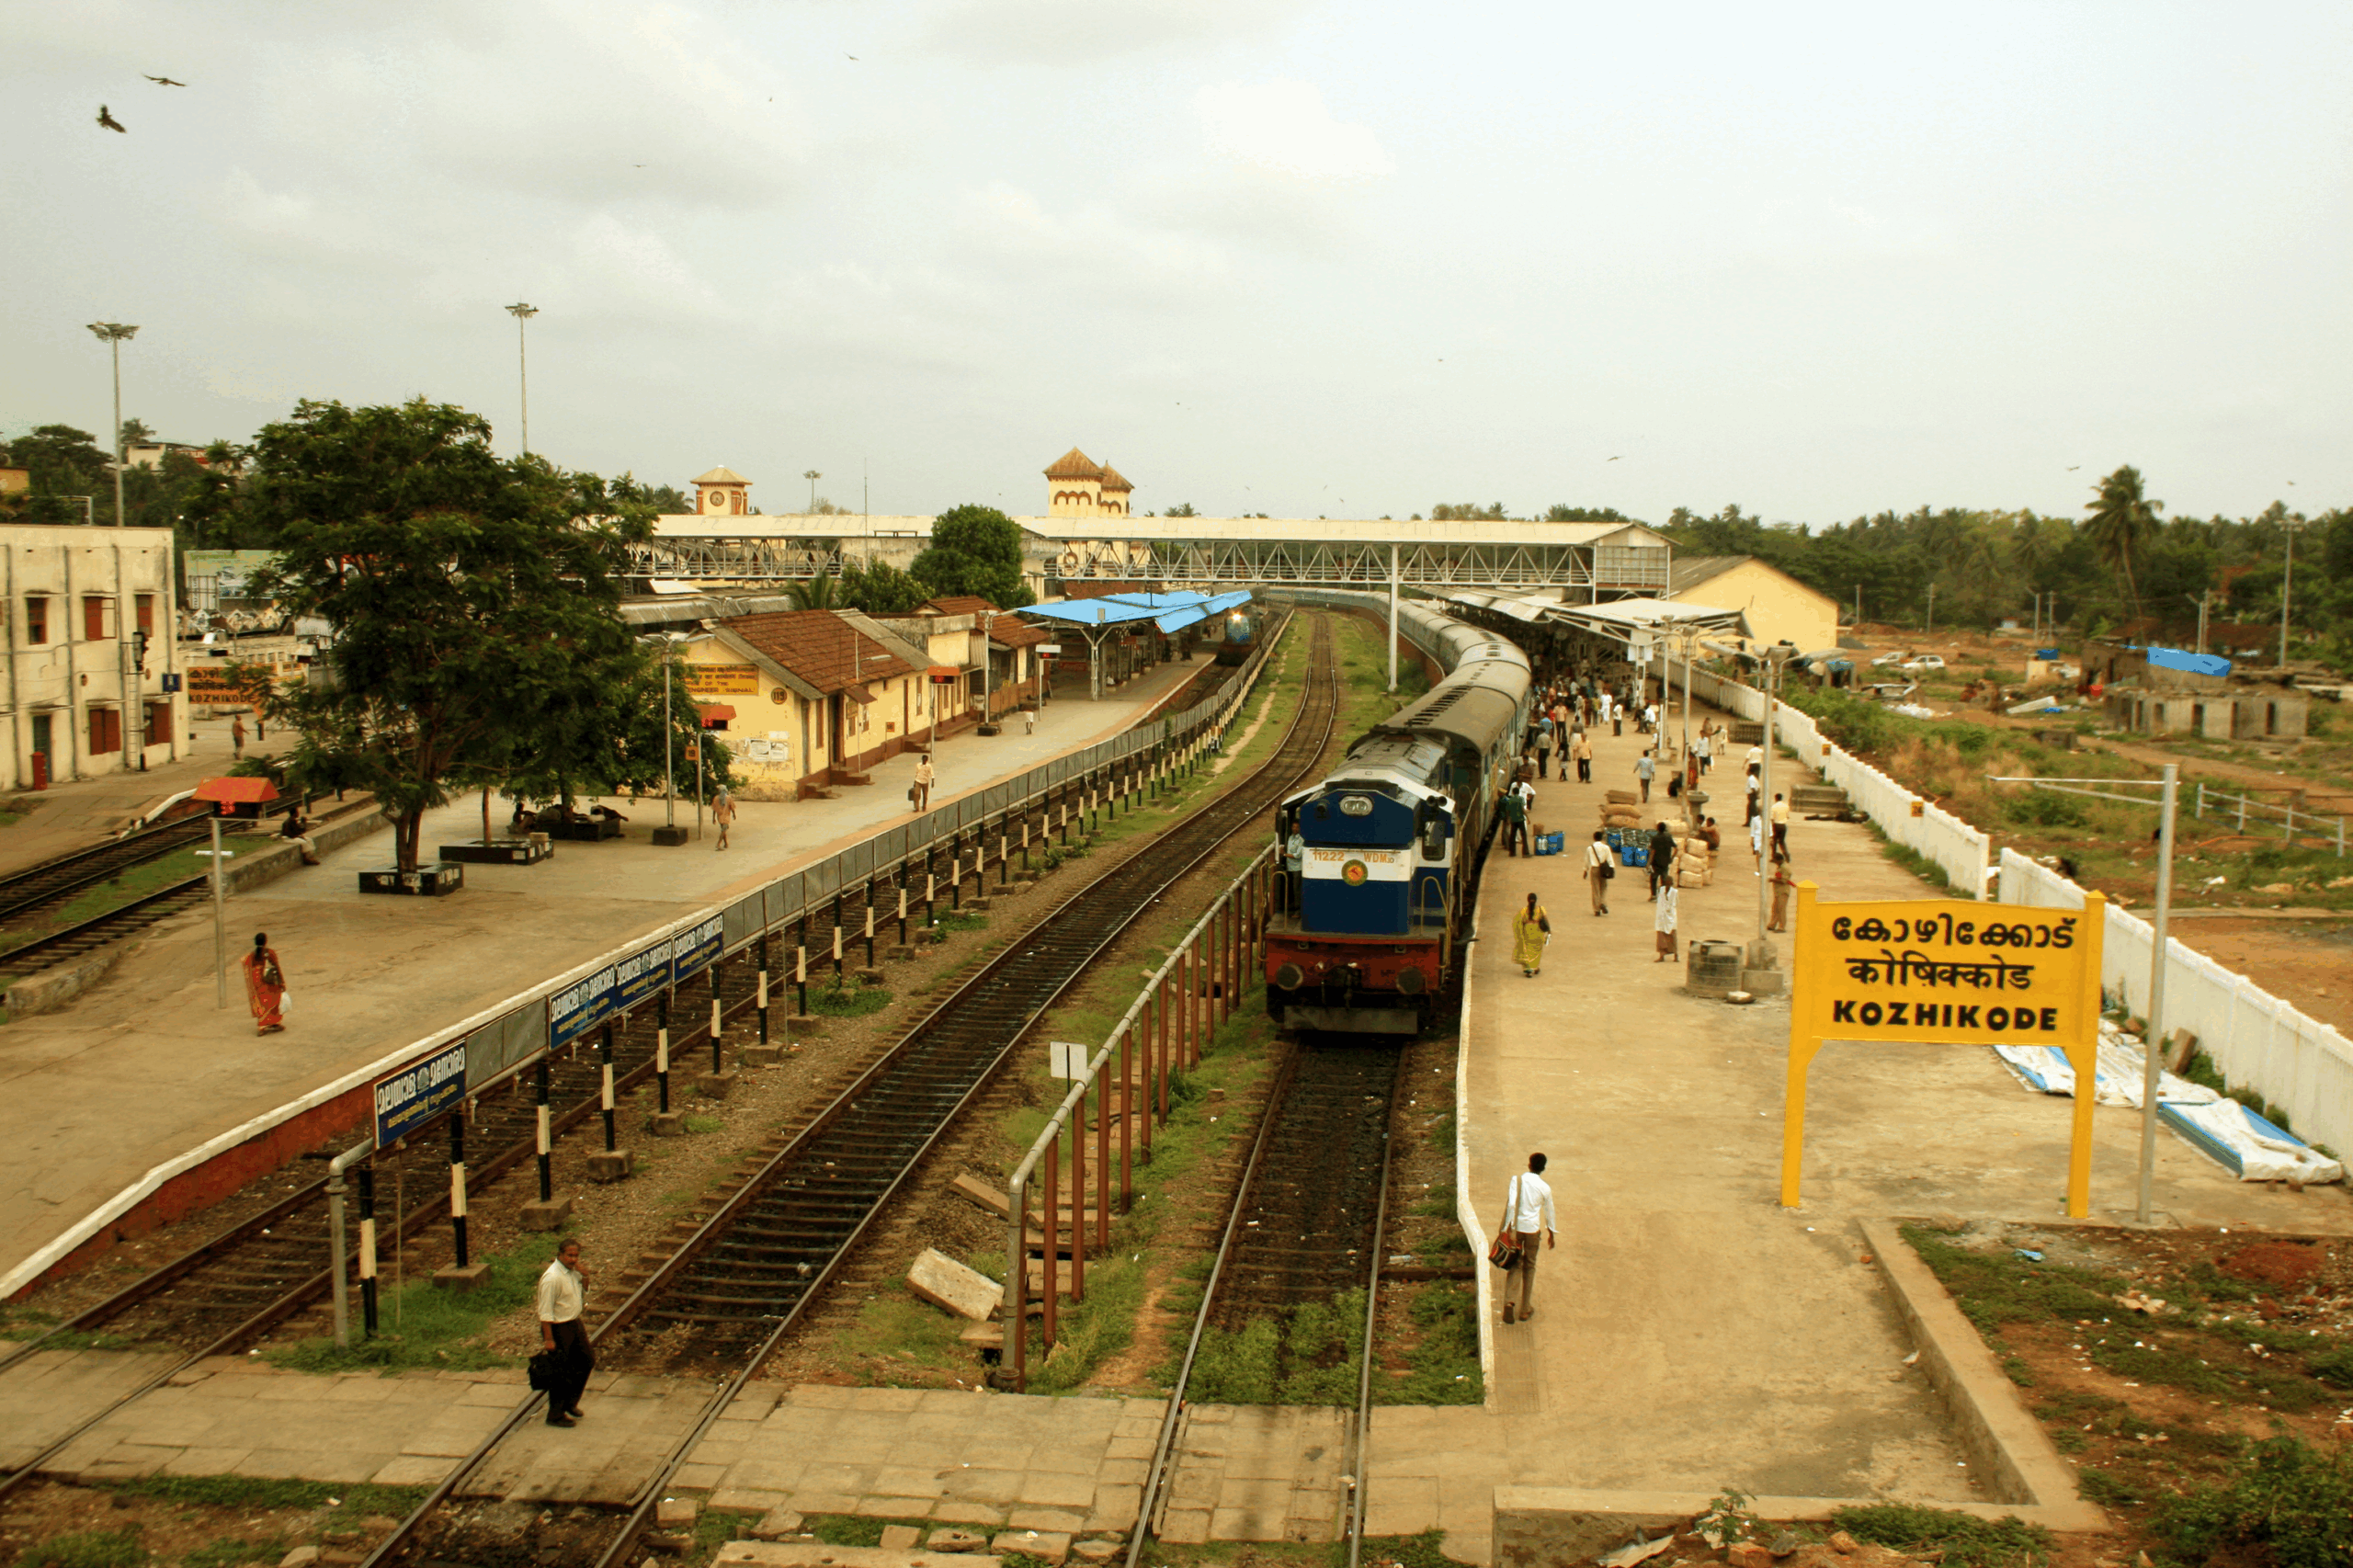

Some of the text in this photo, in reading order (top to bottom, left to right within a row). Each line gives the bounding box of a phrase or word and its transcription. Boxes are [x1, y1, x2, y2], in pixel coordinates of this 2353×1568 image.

[1313, 851, 1345, 861] 11222
[1832, 913, 2076, 949] കോഴിക്കോട്
[1833, 1000, 2058, 1031] KOZHIKODE
